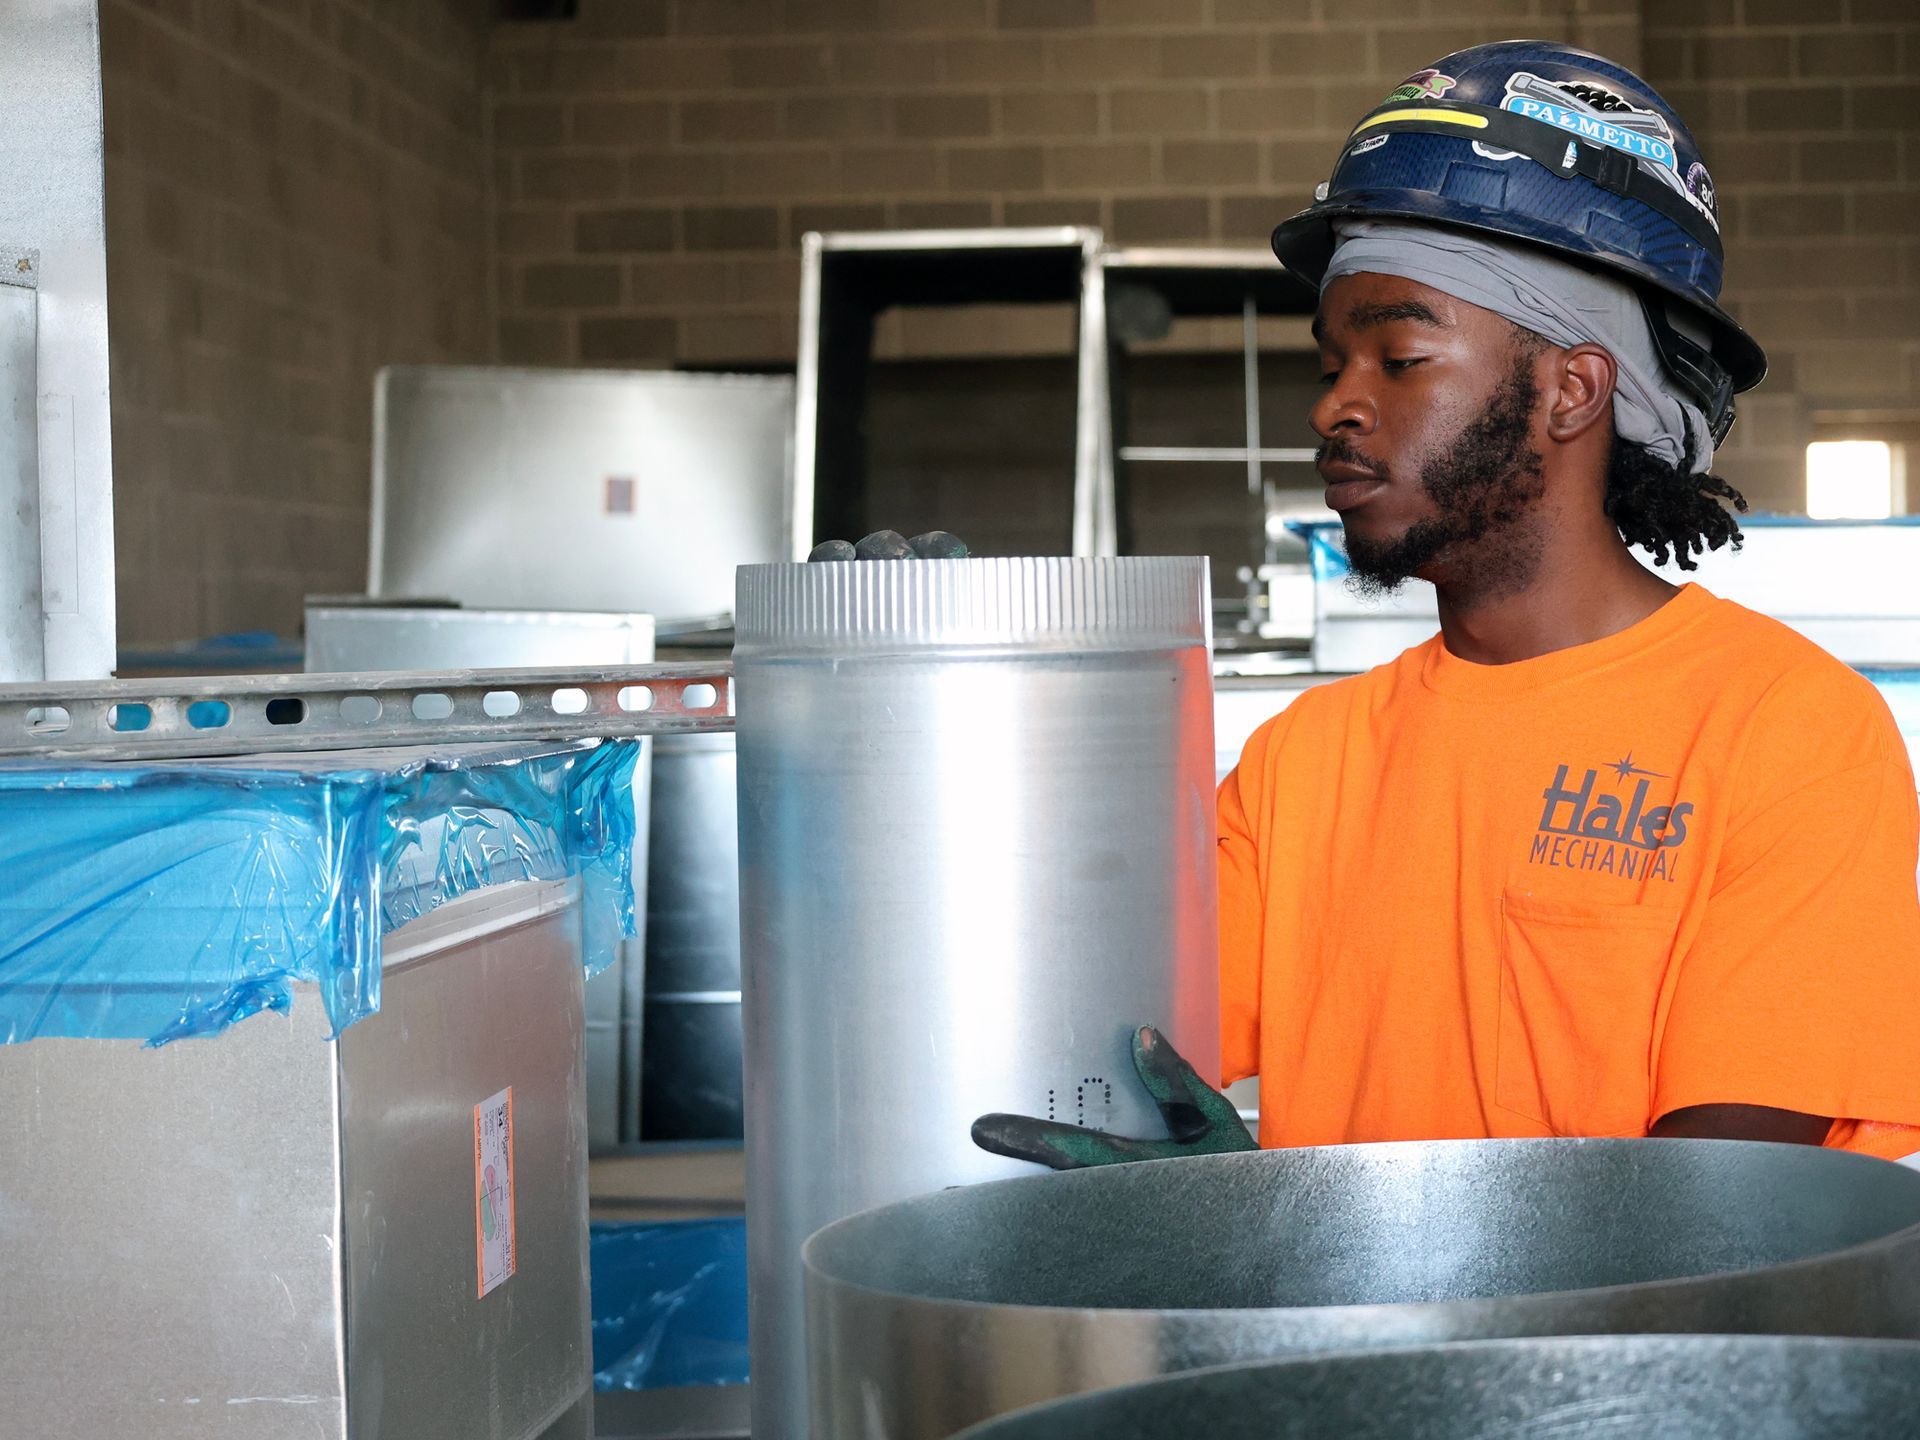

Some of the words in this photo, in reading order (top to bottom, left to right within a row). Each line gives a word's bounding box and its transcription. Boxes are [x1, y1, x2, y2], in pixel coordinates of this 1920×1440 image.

[1521, 101, 1667, 159] PALMETTO
[1538, 764, 1694, 850] Hales
[1529, 834, 1679, 882] MECHANIAL
